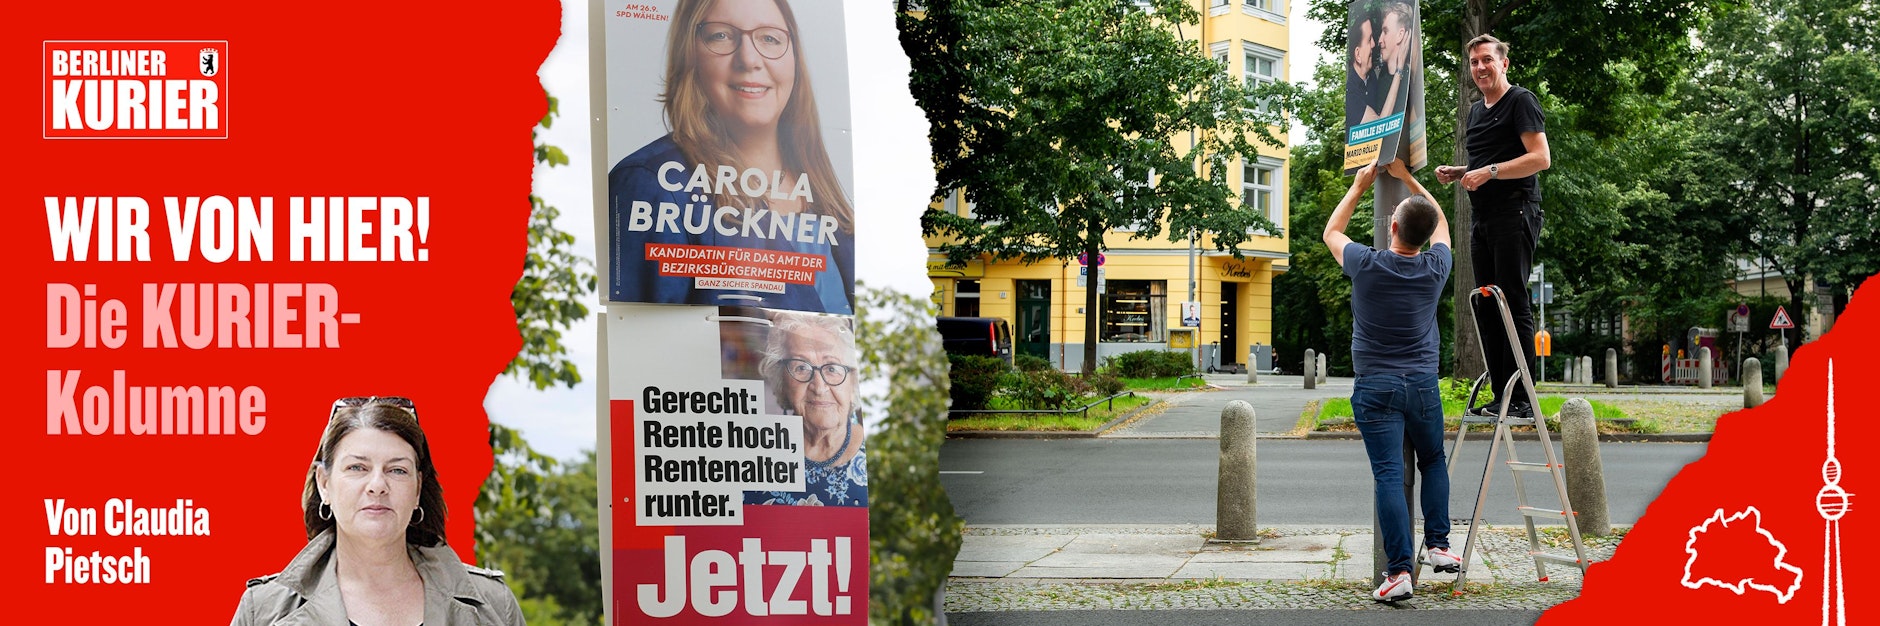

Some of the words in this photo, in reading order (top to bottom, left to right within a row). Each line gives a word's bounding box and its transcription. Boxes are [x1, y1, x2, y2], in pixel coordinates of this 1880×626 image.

[616, 10, 632, 18] SPD
[633, 11, 669, 21] WÄHLEN!
[640, 5, 659, 13] 26.9.
[1352, 126, 1376, 141] FAMILIE
[1376, 123, 1386, 134] IST
[1385, 118, 1401, 131] LIEBE
[1346, 148, 1361, 158] MARIO
[657, 160, 814, 203] CAROLA
[628, 194, 840, 246] BRÜCKNER
[650, 246, 726, 260] KANDIDATIN
[728, 248, 751, 262] FÜR
[753, 254, 775, 264] DAS
[776, 256, 800, 266] AMT
[801, 257, 823, 269] DER
[662, 262, 813, 282] BEZIRKSBÜRGERMEISTERIN
[722, 280, 750, 289] SICHER
[751, 283, 784, 292] SPANDAU
[643, 386, 757, 414] Gerecht:
[644, 421, 722, 449] Rente
[728, 421, 796, 453] hoch,
[644, 455, 798, 484] Rentenalter
[645, 490, 735, 518] runter.
[636, 535, 852, 618] Jetzt!
